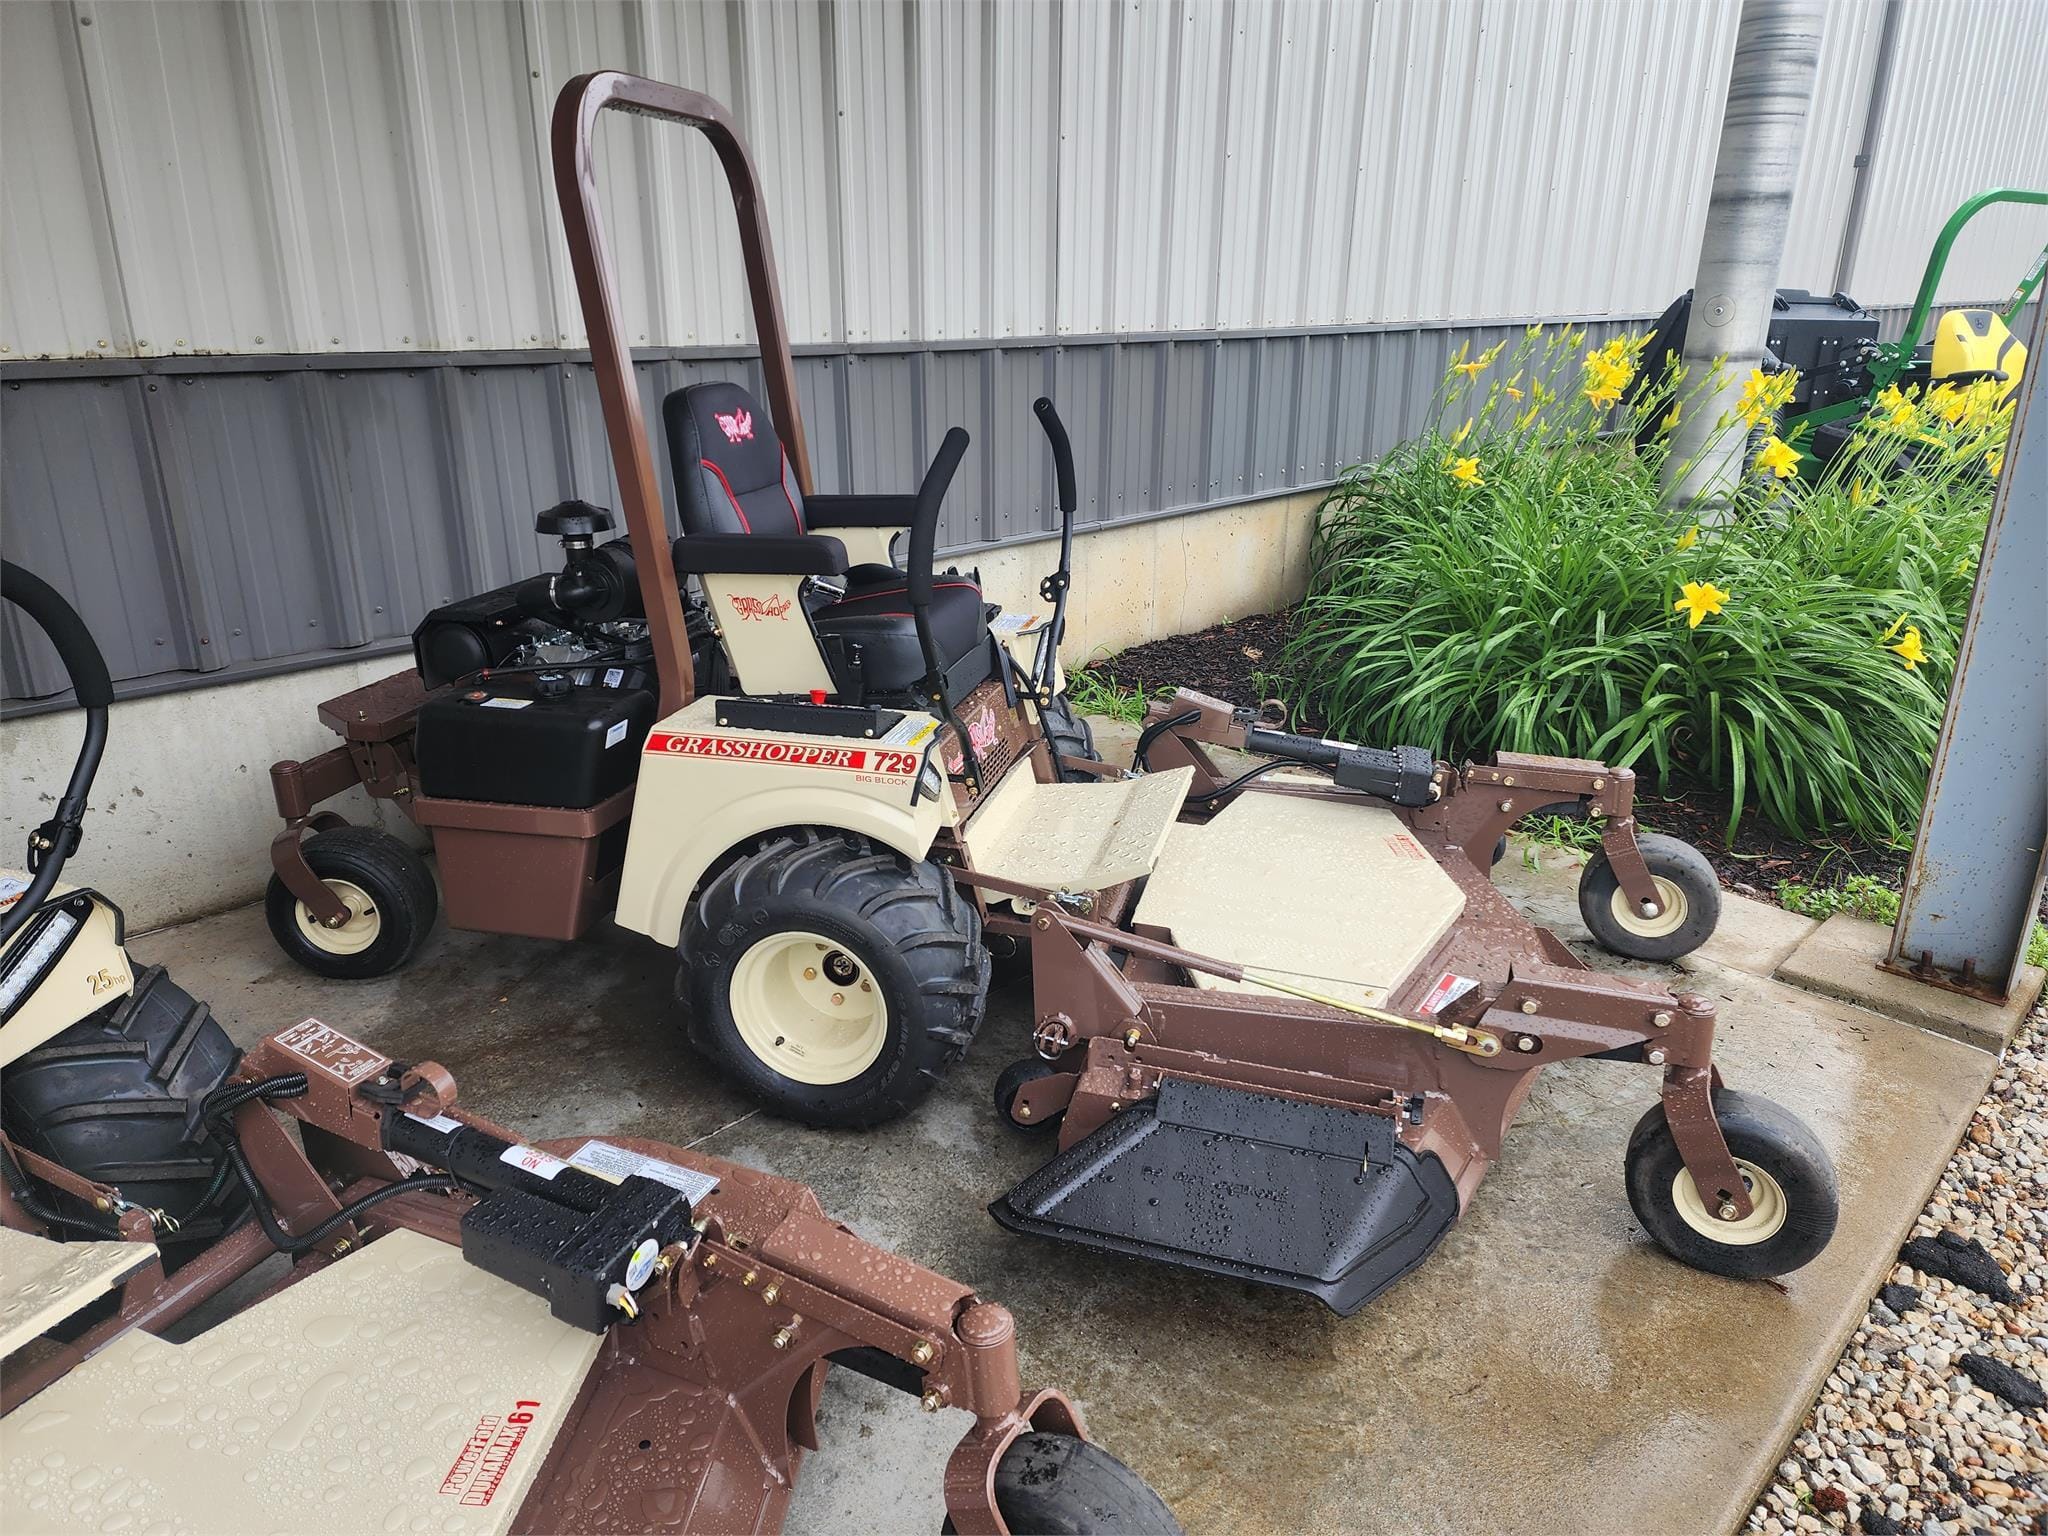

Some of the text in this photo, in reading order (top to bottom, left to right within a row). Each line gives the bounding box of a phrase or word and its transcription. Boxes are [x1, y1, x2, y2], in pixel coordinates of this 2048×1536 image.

[665, 736, 853, 767] GRASSHOPPER
[873, 751, 917, 774] 729
[855, 775, 908, 786] BIG BLOCK
[521, 1158, 543, 1169] NO
[507, 1400, 541, 1424] 61
